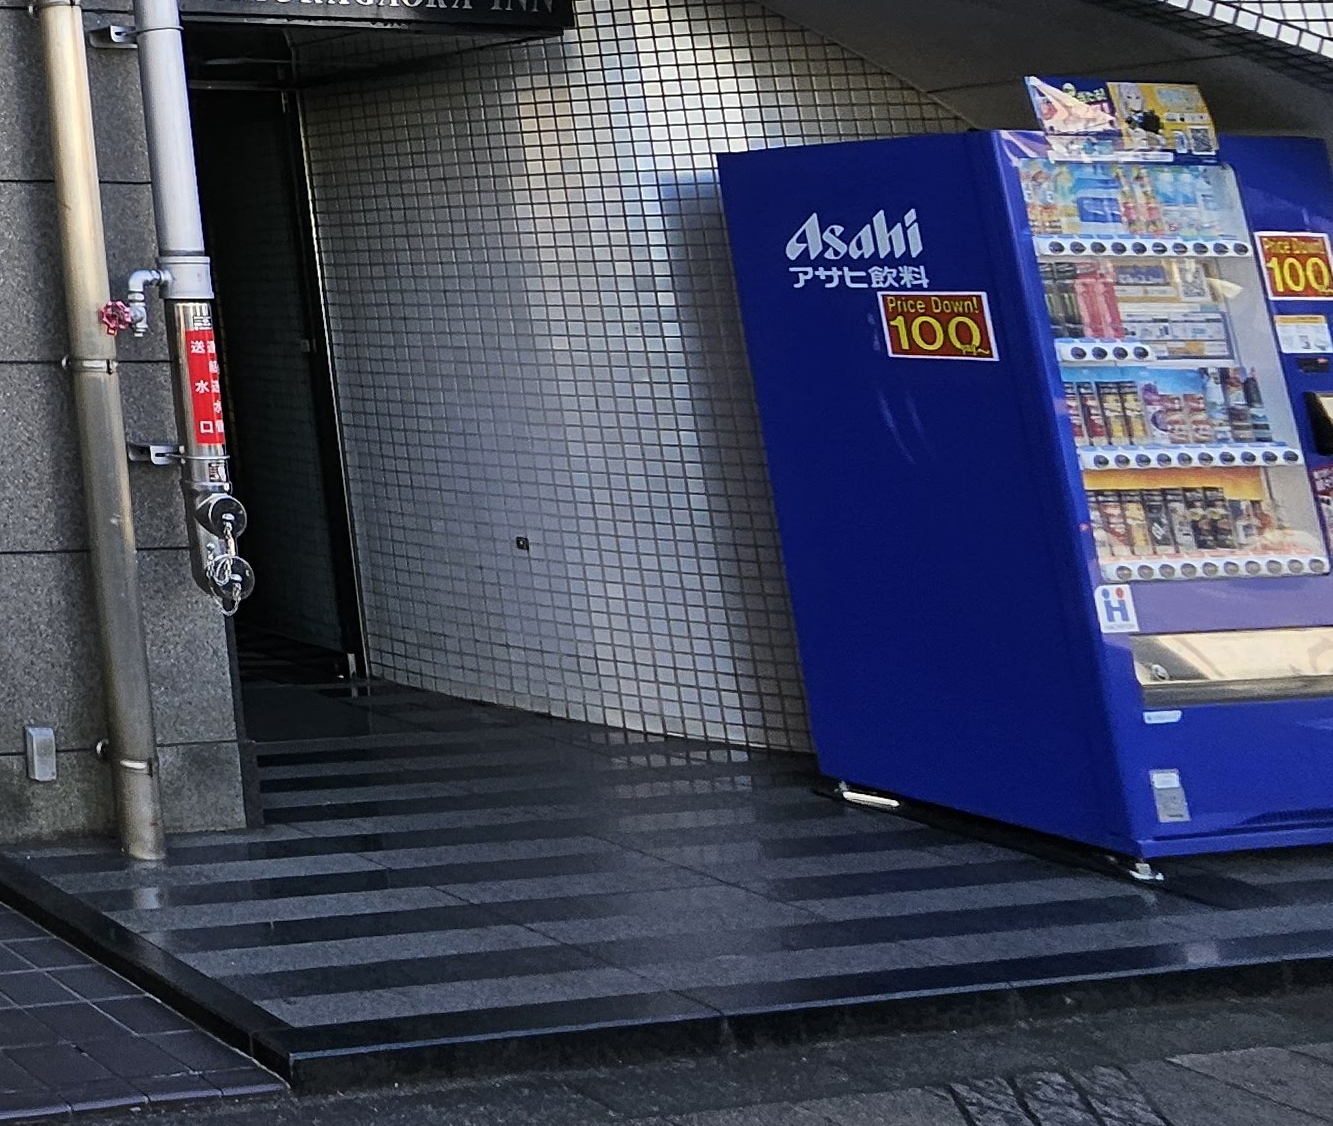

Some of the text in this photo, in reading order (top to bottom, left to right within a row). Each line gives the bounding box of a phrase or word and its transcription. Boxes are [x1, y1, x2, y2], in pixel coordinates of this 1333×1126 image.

[785, 208, 923, 260] Asahi
[789, 265, 929, 289] アサヒ飲料
[887, 296, 980, 314] Price Down!
[190, 340, 214, 434] 送水口
